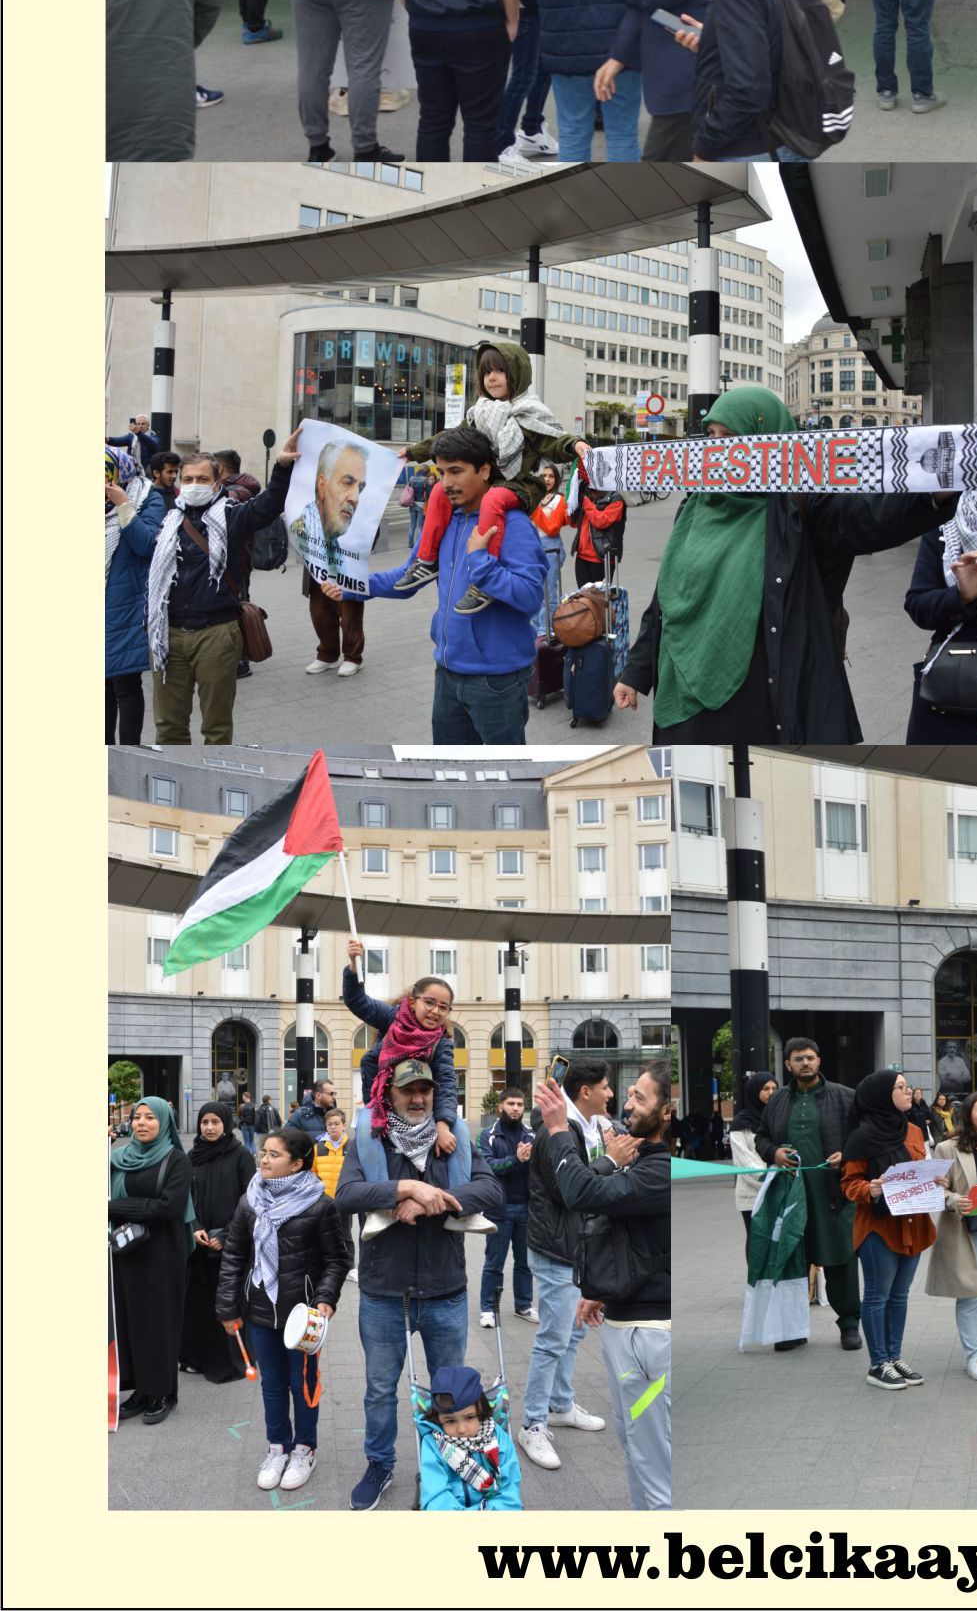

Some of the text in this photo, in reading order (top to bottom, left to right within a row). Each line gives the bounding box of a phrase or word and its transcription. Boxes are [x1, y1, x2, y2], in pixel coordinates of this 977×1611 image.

[324, 339, 434, 366] BREWDOG
[640, 437, 860, 487] PALESTINE
[328, 557, 343, 566] par
[116, 1227, 135, 1248] 81
